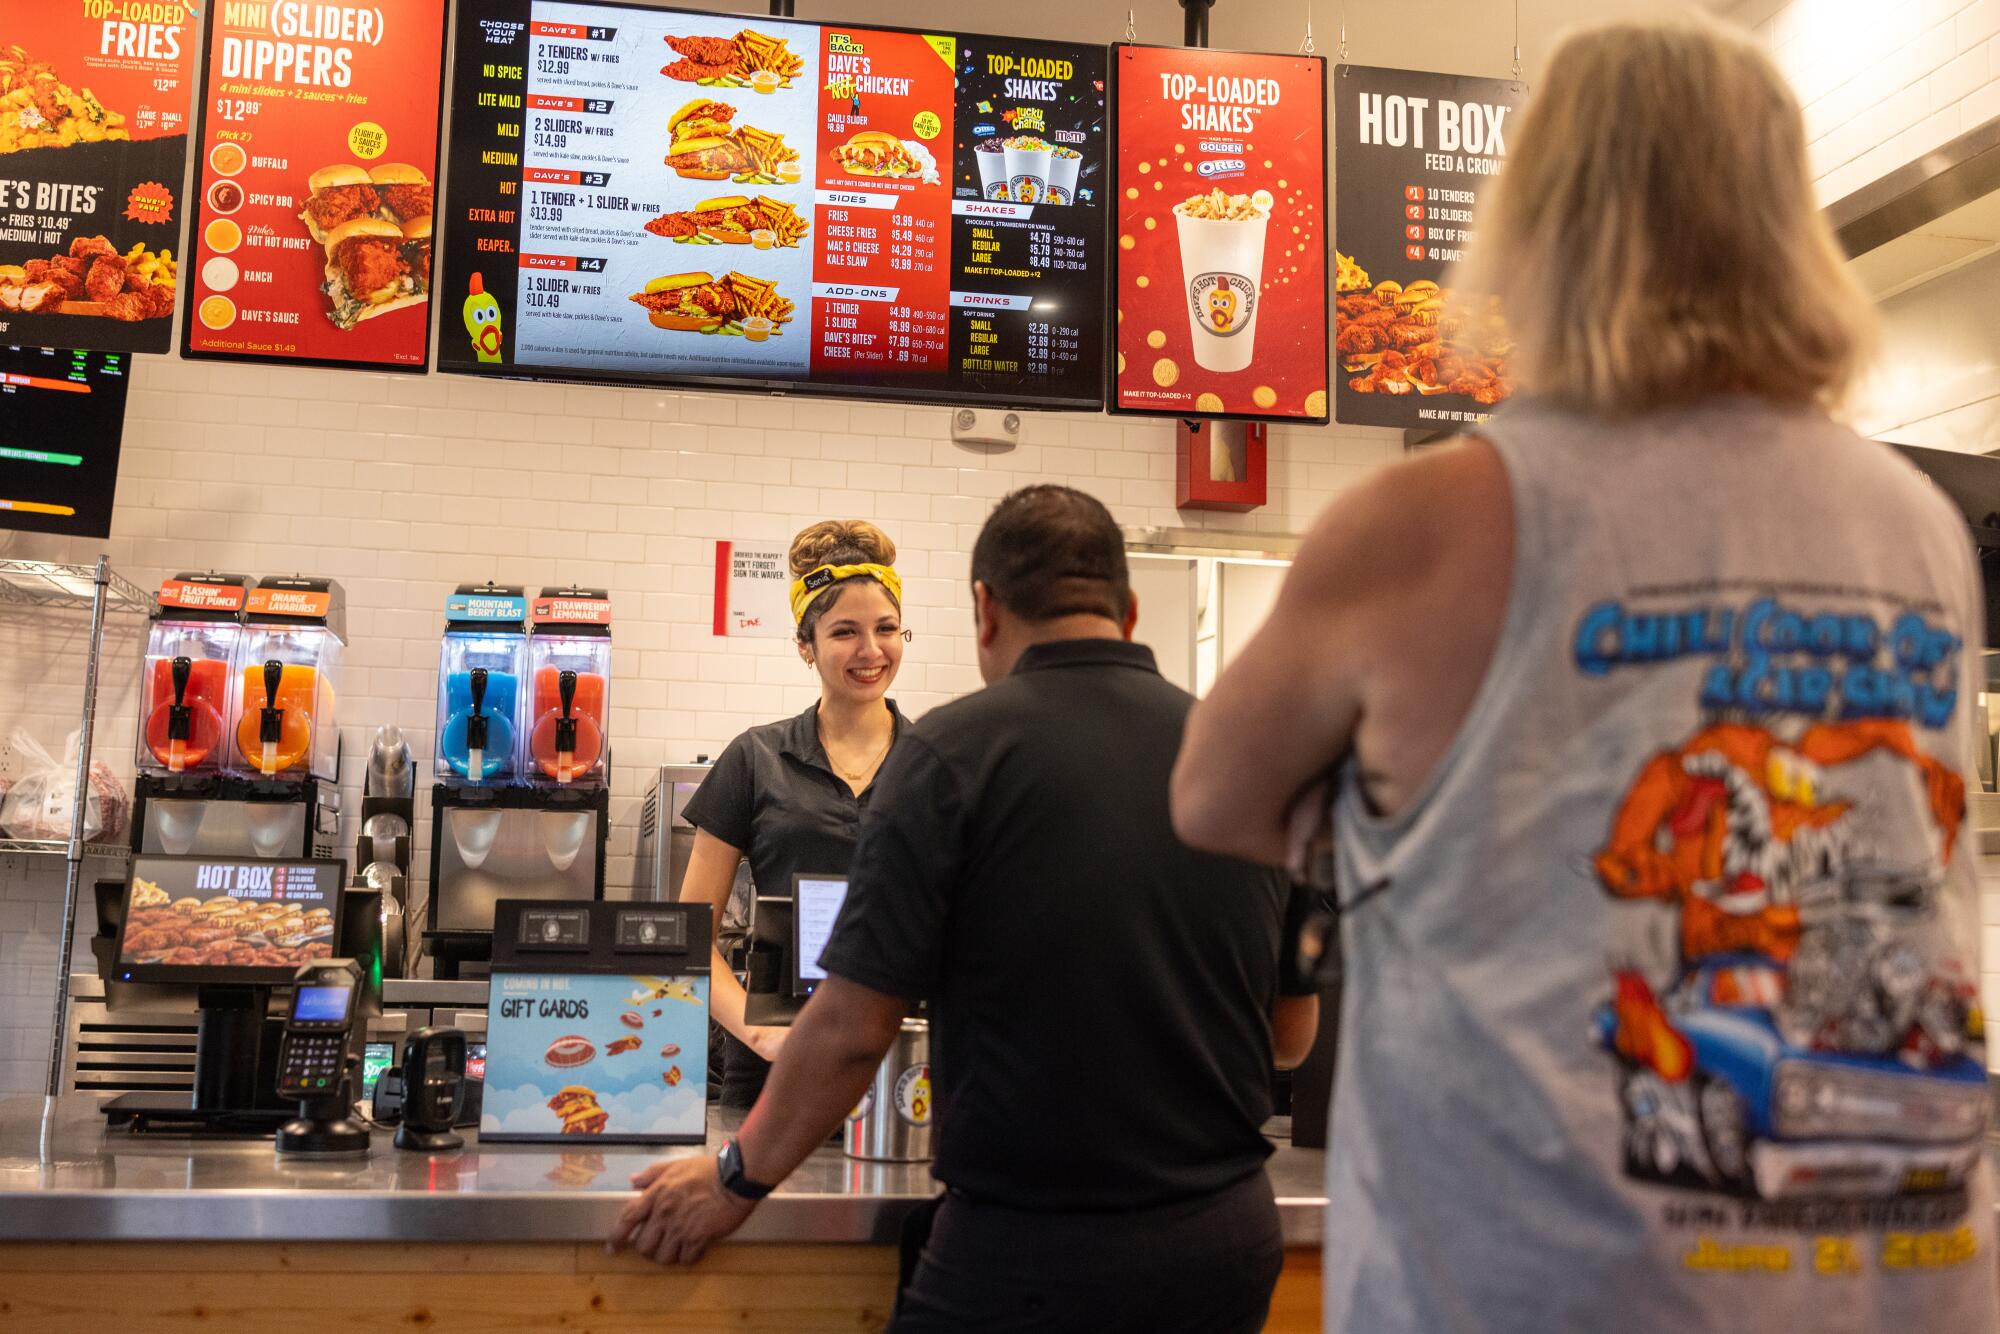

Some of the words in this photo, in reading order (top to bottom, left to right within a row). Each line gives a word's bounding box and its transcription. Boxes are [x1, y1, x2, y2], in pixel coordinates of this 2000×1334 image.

[84, 0, 185, 24] TOP-LOADED
[224, 1, 266, 29] MINI
[271, 0, 384, 46] (SLIDER)
[480, 20, 524, 30] CHOOSE
[485, 29, 516, 37] YOUR
[540, 26, 577, 35] DAVE'S
[592, 29, 606, 39] #1
[831, 35, 849, 43] IT'S
[485, 36, 514, 45] HEAT
[539, 44, 545, 57] 2
[548, 45, 588, 61] TENDERS
[602, 54, 620, 63] FRIES
[831, 44, 862, 53] BACK!
[222, 37, 352, 88] DIPPERS
[538, 61, 569, 75] $12.99
[828, 55, 870, 74] DAVE'S
[987, 54, 1073, 81] TOP-LOADED
[483, 64, 495, 77] NO
[498, 65, 522, 79] SPICE
[229, 84, 251, 94] mini
[252, 86, 285, 97] sliders
[346, 92, 368, 104] fries
[1161, 73, 1280, 106] TOP-LOADED
[478, 93, 497, 106] LITE
[499, 95, 521, 108] MILD
[537, 99, 573, 108] DAVE'S
[588, 101, 606, 112] #2
[162, 112, 182, 122] SMALL
[827, 114, 845, 123] CAULI
[1016, 107, 1044, 119] Lucky
[1012, 118, 1045, 133] Charms
[1360, 92, 1428, 148] HOT
[497, 123, 519, 137] MILD
[535, 118, 541, 131] 2
[544, 119, 582, 134] SLIDERS
[596, 127, 613, 137] FRIES
[359, 137, 380, 149] SAUCES
[534, 134, 566, 148] $14.99
[1200, 142, 1243, 154] GOLDEN
[252, 156, 287, 169] BUFFALO
[483, 151, 518, 166] MEDIUM
[1425, 153, 1453, 172] FEED
[1457, 156, 1464, 172] A
[1198, 160, 1244, 176] OREO
[534, 172, 570, 180] DAVE'S
[585, 174, 603, 184] #3
[500, 182, 517, 195] HOT
[249, 193, 273, 206] SPICY
[276, 195, 292, 208] BBQ
[829, 194, 867, 203] SIDES
[1427, 188, 1438, 201] 10
[1441, 189, 1474, 203] TENDERS
[541, 192, 575, 207] TENDER
[597, 195, 629, 211] SLIDER
[643, 203, 660, 213] FRIES
[531, 207, 562, 222] $13.99
[828, 210, 848, 222] FRIES
[966, 204, 1016, 215] SHAKES
[1428, 208, 1439, 219] 10
[1441, 209, 1472, 222] SLIDERS
[9, 214, 34, 227] FRIES
[469, 209, 496, 223] EXTRA
[499, 211, 515, 224] HOT
[0, 229, 36, 242] MEDIUM
[45, 231, 61, 244] HOT
[828, 225, 854, 237] CHEESE
[856, 227, 876, 239] FRIES
[973, 228, 994, 239] SMALL
[1428, 228, 1444, 240] BOX
[1446, 229, 1456, 241] OF
[247, 235, 262, 247] HOT
[265, 236, 281, 247] HOT
[283, 238, 310, 250] HONEY
[827, 240, 843, 252] MAC
[853, 242, 879, 254] CHEESE
[973, 240, 1000, 252] REGULAR
[827, 254, 844, 266] KALE
[847, 255, 868, 267] SLAW
[972, 253, 992, 263] LARGE
[1429, 248, 1439, 260] 40
[529, 258, 566, 266] DAVE'S
[581, 260, 600, 270] #4
[244, 270, 272, 282] RANCH
[965, 266, 982, 274] MAKE
[990, 268, 1030, 278] TOP-LOADED
[537, 278, 569, 293] SLIDER
[583, 286, 600, 295] FRIES
[826, 287, 887, 297] ADD-ONS
[527, 293, 559, 308] $10.49
[963, 296, 1010, 305] DRINKS
[1199, 277, 1216, 290] HOT
[1230, 278, 1254, 313] CHICKEN
[833, 303, 859, 315] TENDER
[242, 310, 271, 322] DAVE'S
[273, 311, 299, 324] SAUCE
[575, 313, 590, 321] pickles
[832, 317, 856, 329] SLIDER
[971, 320, 991, 331] SMALL
[824, 332, 850, 344] DAVE'S
[971, 333, 997, 344] REGULAR
[247, 342, 272, 351] Sauce
[824, 346, 850, 358] CHEESE
[970, 345, 989, 356] LARGE
[963, 359, 992, 371] BOTTLED
[994, 360, 1018, 372] WATER
[1124, 390, 1139, 398] MAKE
[1146, 391, 1181, 399] TOP-LOADED
[1419, 409, 1436, 419] MAKE
[1438, 411, 1449, 420] ANY
[1451, 411, 1462, 421] HOT
[734, 560, 750, 568] DON'T
[752, 561, 775, 570] FORGET!
[734, 569, 747, 578] SIGN
[749, 570, 759, 578] THE
[182, 585, 221, 596] FLASHIN'
[180, 594, 204, 605] FRUIT
[206, 596, 237, 607] PUNCH
[271, 593, 306, 604] ORANGE
[468, 599, 512, 609] MOUNTAIN
[268, 602, 317, 614] LAVABURST
[468, 608, 496, 617] BERRY
[497, 608, 521, 618] BLAST
[553, 601, 610, 612] STRAWBERRY
[552, 610, 599, 621] LEMONADE
[196, 865, 234, 889] HOT
[237, 867, 274, 890] BOX
[501, 999, 535, 1018] GIFT
[539, 999, 589, 1019] CARDS
